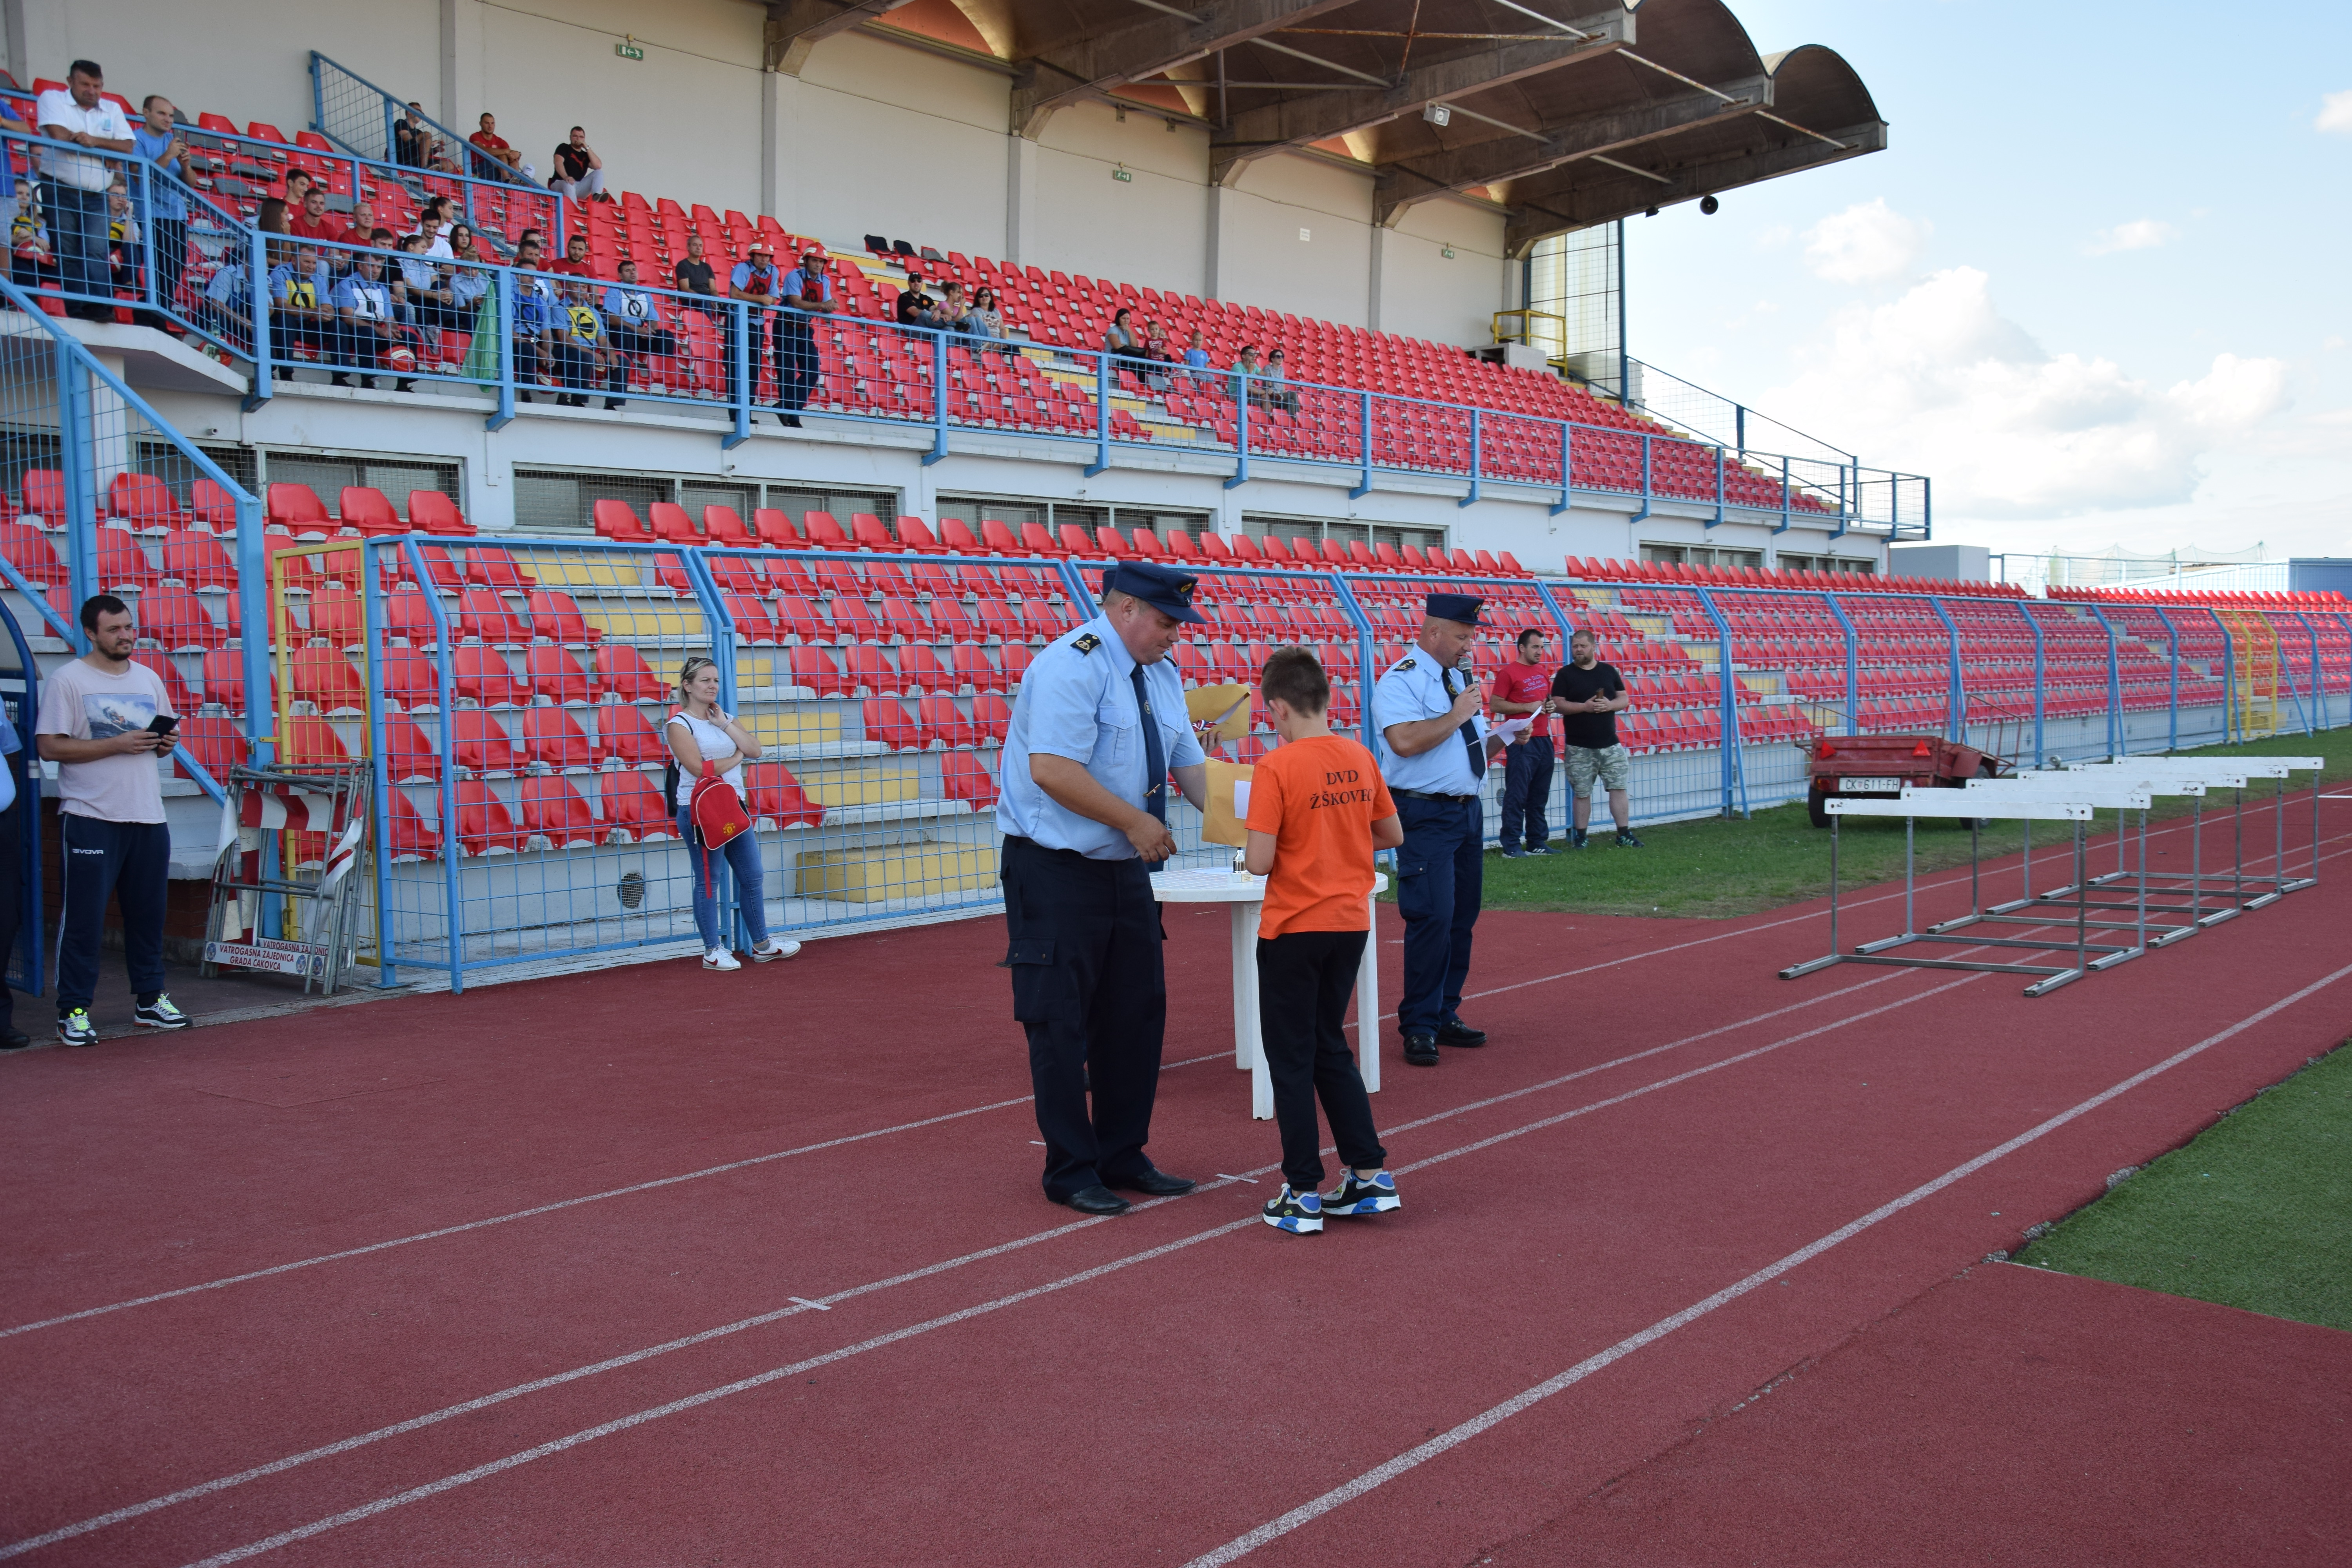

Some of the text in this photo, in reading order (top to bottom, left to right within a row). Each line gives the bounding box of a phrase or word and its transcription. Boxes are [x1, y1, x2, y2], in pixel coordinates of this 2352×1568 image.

[1325, 770, 1358, 785] DVD
[1310, 789, 1372, 809] ŽŠKOVEC
[220, 944, 294, 962] VATROGASNA ZAJEDNICA
[263, 940, 328, 955] VATROGASNA ZADNIC
[230, 956, 281, 971] GRADA ČAKOVCA
